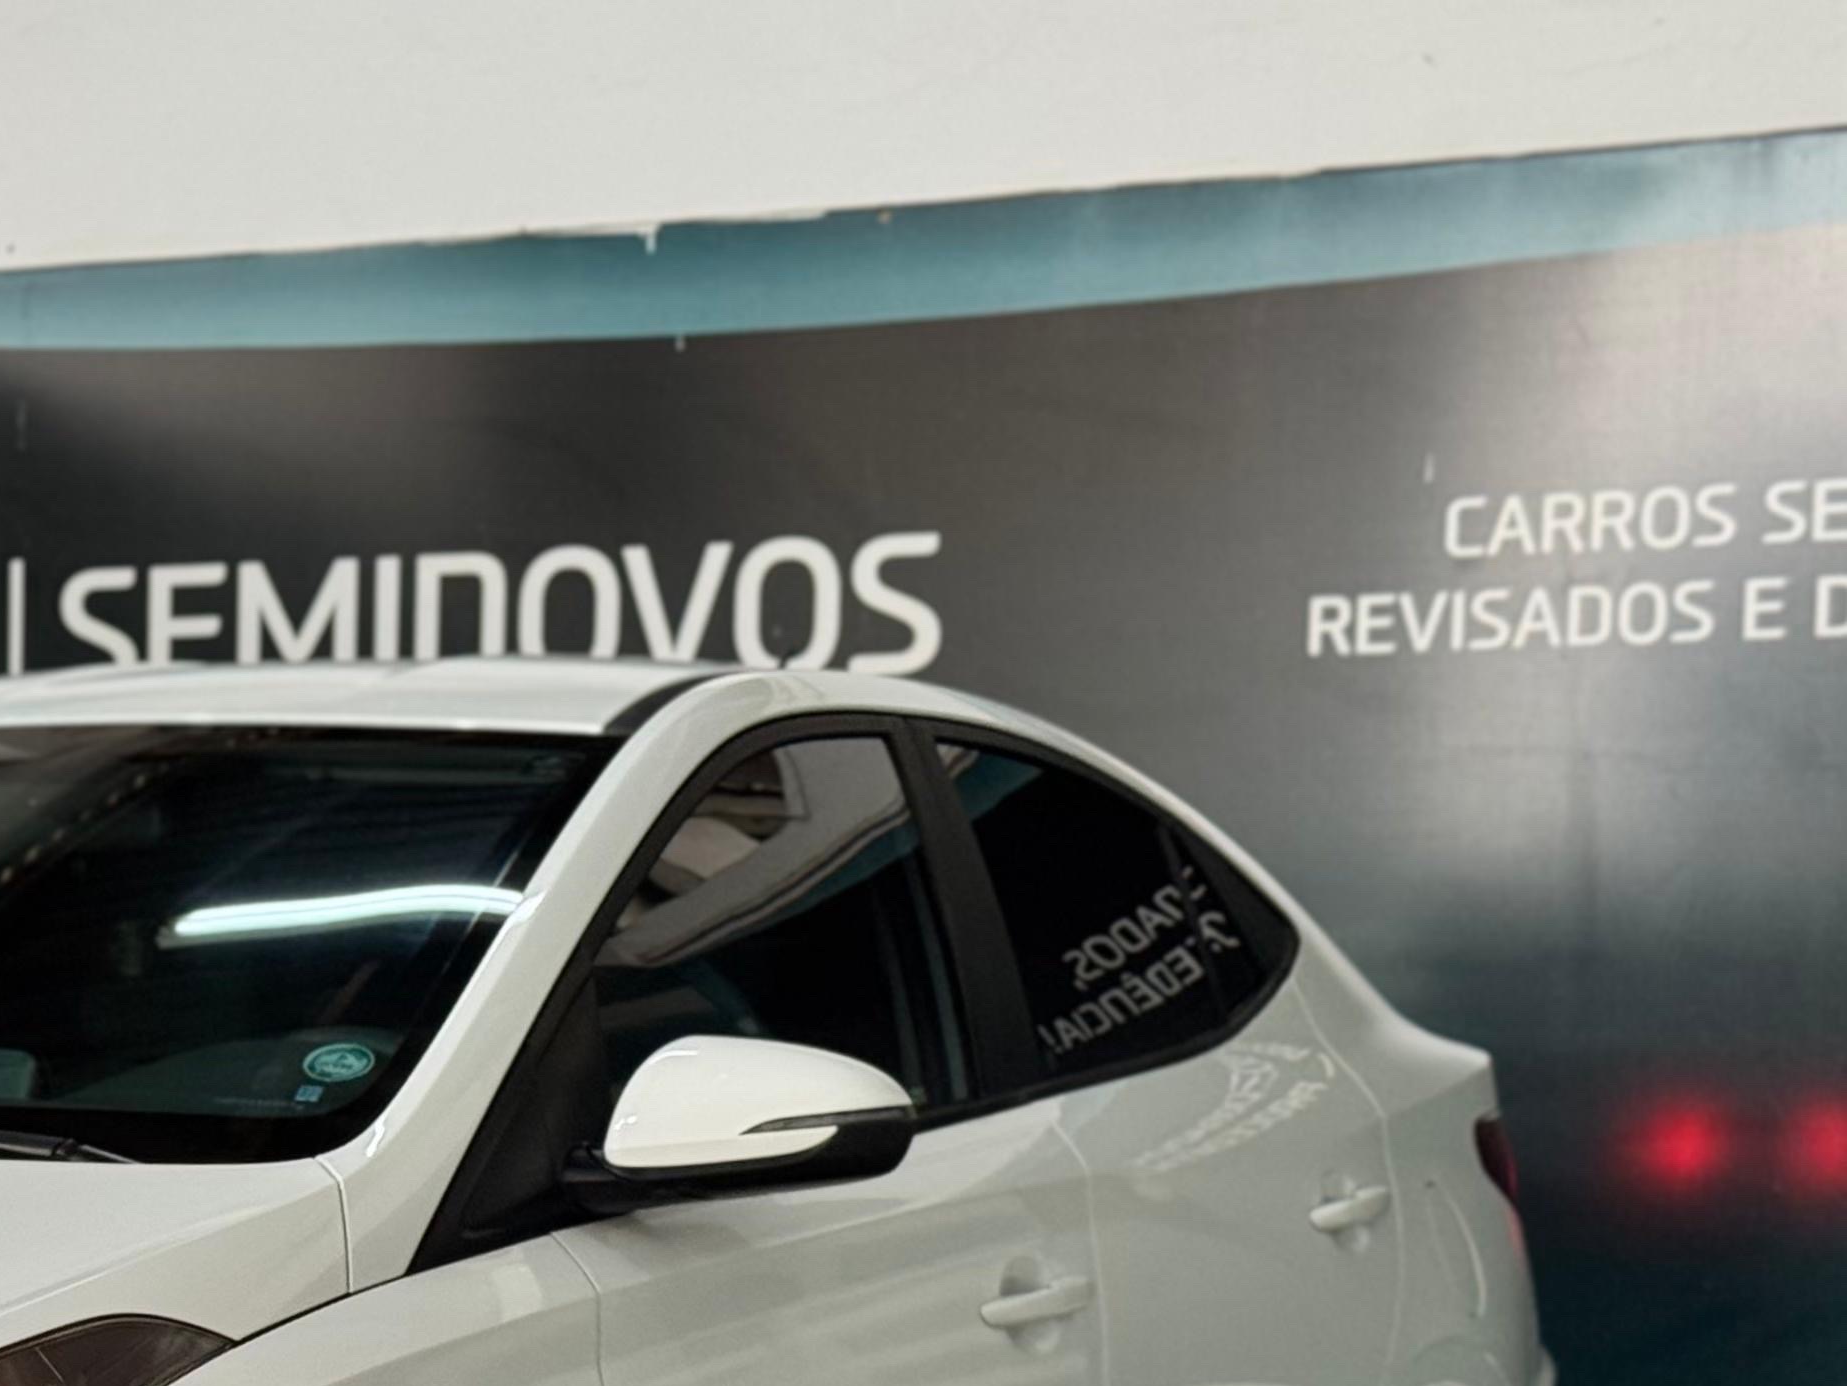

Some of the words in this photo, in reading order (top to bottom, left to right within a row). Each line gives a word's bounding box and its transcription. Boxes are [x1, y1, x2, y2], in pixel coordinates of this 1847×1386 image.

[1444, 483, 1738, 559] CARROS
[1761, 478, 1847, 545] SE
[59, 530, 943, 676] SEMINOVOS
[1307, 579, 1716, 657] REVISADOS
[1742, 576, 1793, 641] E
